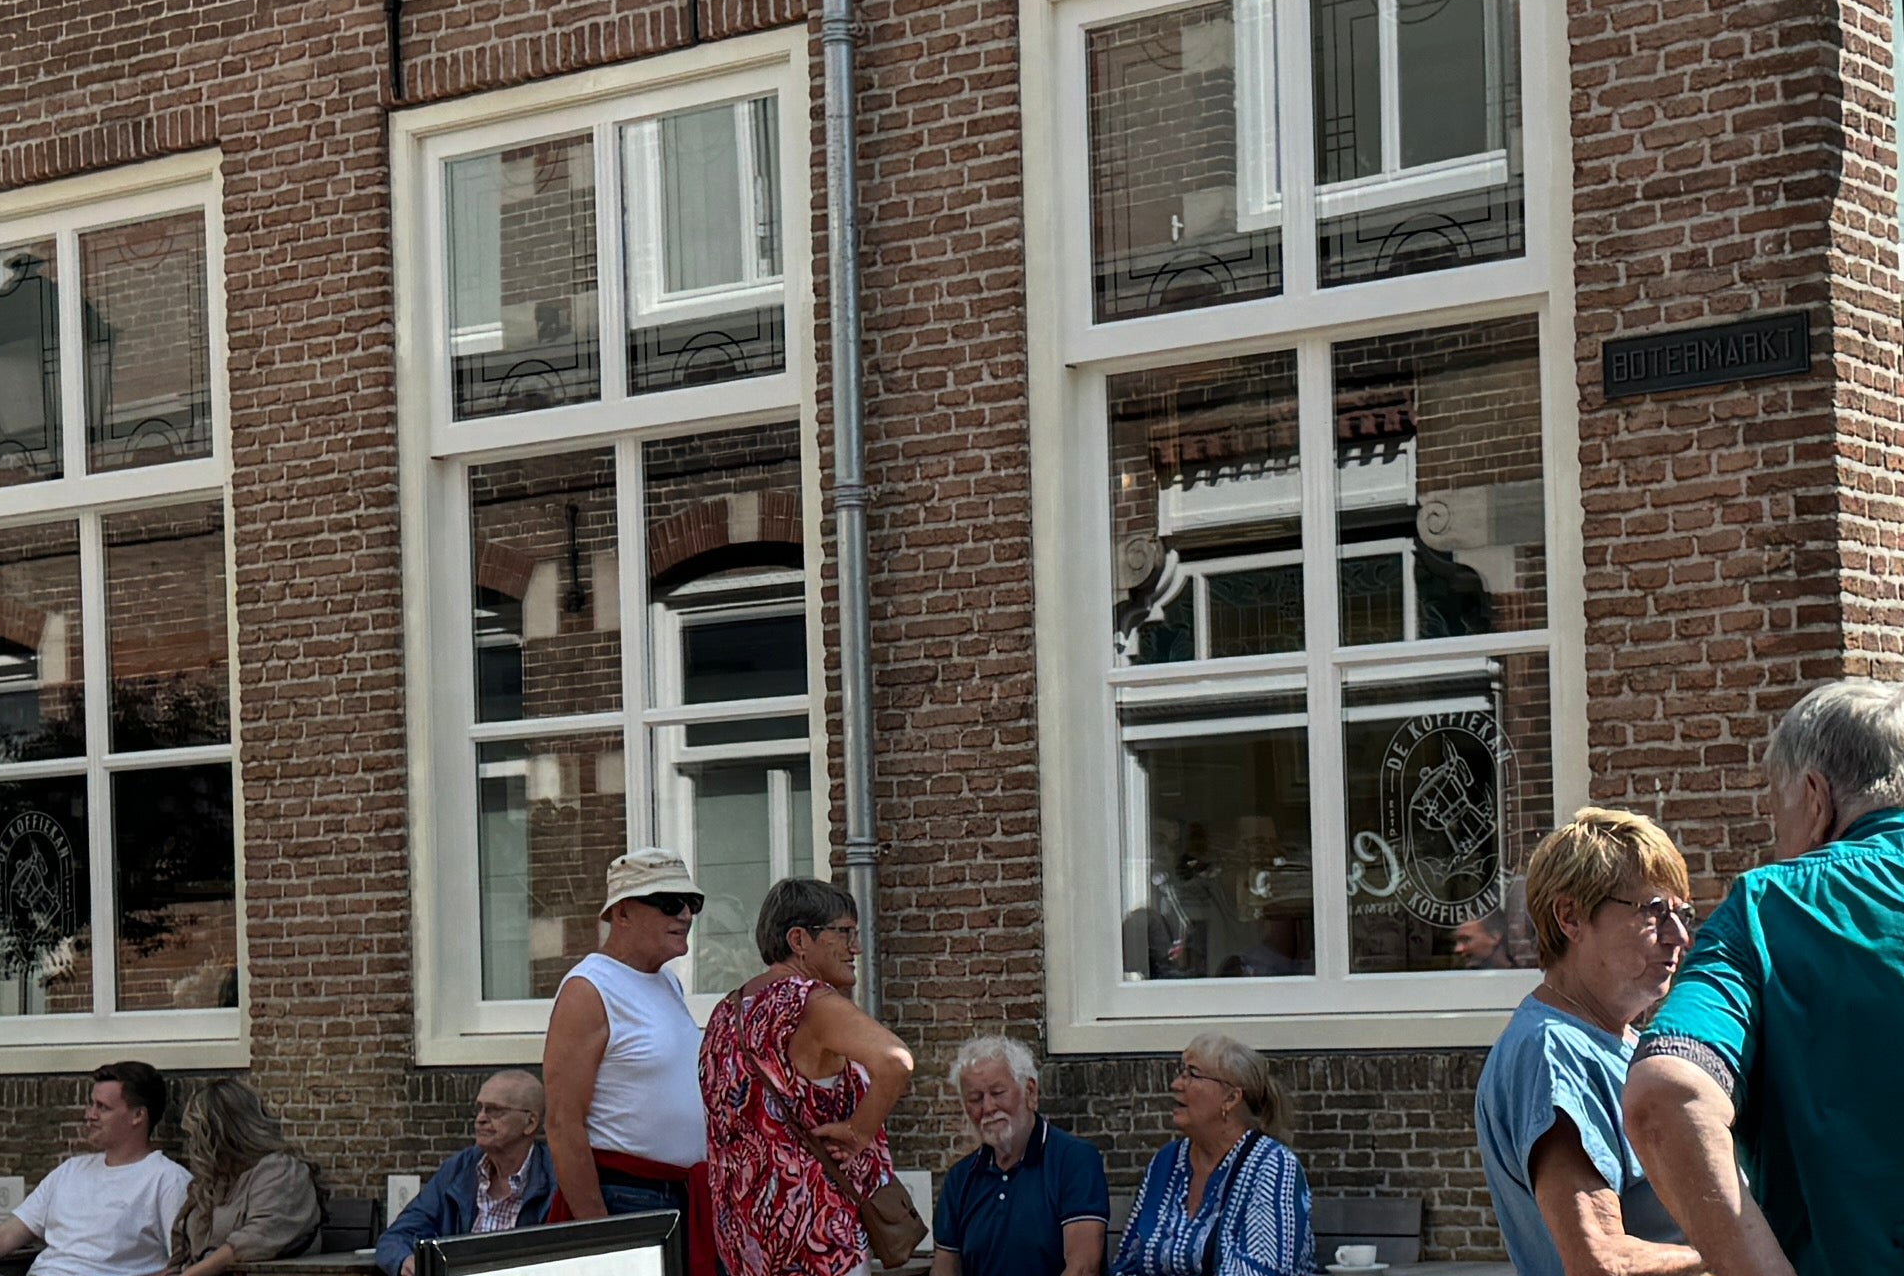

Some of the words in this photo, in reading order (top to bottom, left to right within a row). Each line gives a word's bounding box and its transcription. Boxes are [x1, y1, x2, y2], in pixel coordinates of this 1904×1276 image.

[1612, 327, 1794, 383] BOTERMARKT
[1386, 741, 1409, 772] DE
[1408, 710, 1513, 765] KOFFIEKAN
[8, 814, 70, 859] KOFFIEKAN
